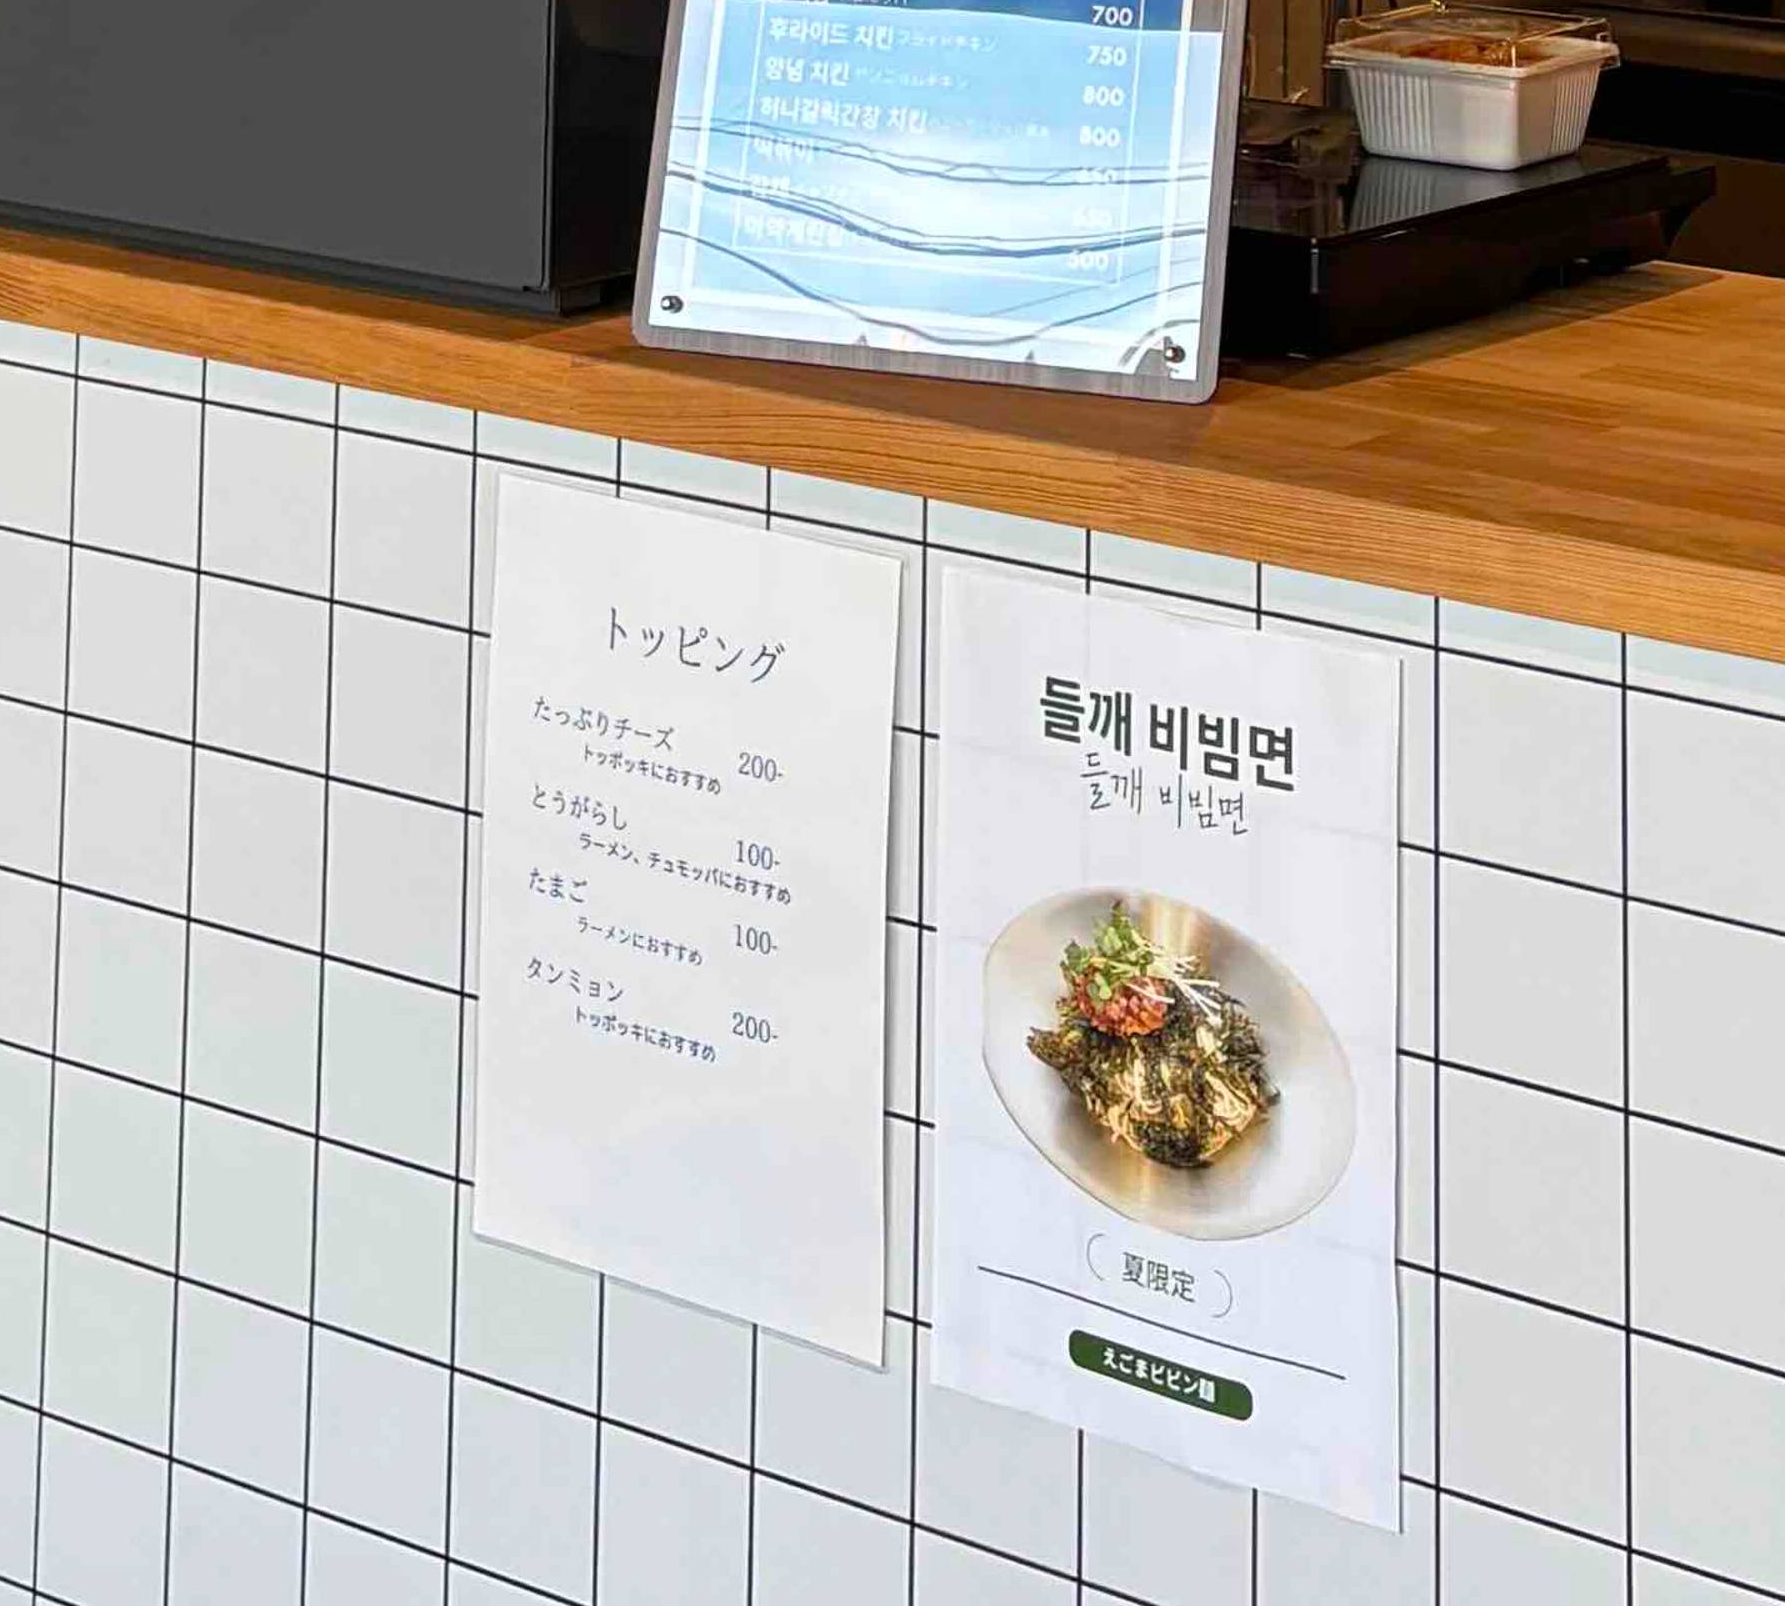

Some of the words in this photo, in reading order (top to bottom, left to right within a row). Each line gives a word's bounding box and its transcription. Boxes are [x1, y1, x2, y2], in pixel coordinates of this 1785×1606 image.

[770, 17, 849, 45] 후라이드
[854, 24, 895, 50] 치킨
[1087, 46, 1128, 67] 750
[1091, 6, 1133, 27] 700
[766, 57, 806, 84] 양념
[810, 59, 851, 87] 치킨
[1083, 86, 1124, 107] 800
[887, 107, 928, 135] 치킨
[1079, 127, 1121, 148] 800
[609, 606, 787, 683] トッピング
[533, 695, 674, 750] たっぷりチーズ
[738, 752, 784, 782] 200-
[1039, 677, 1133, 757] 들깨
[1148, 703, 1297, 793] 비빔면
[584, 745, 720, 795] トッポッキにおすすめ
[1081, 752, 1144, 816] 들깨
[1158, 773, 1248, 837] 비빔면
[532, 783, 628, 831] とうがらし
[735, 840, 780, 870] 100-
[529, 867, 587, 904] たまご
[734, 924, 778, 954] 100-
[578, 916, 702, 966] ラーメンにおすすめ
[527, 957, 624, 1002] タンミョン
[732, 1012, 778, 1043] 200-
[576, 1005, 715, 1063] トッポッキにおすすめ
[1122, 1249, 1196, 1305] 夏限定
